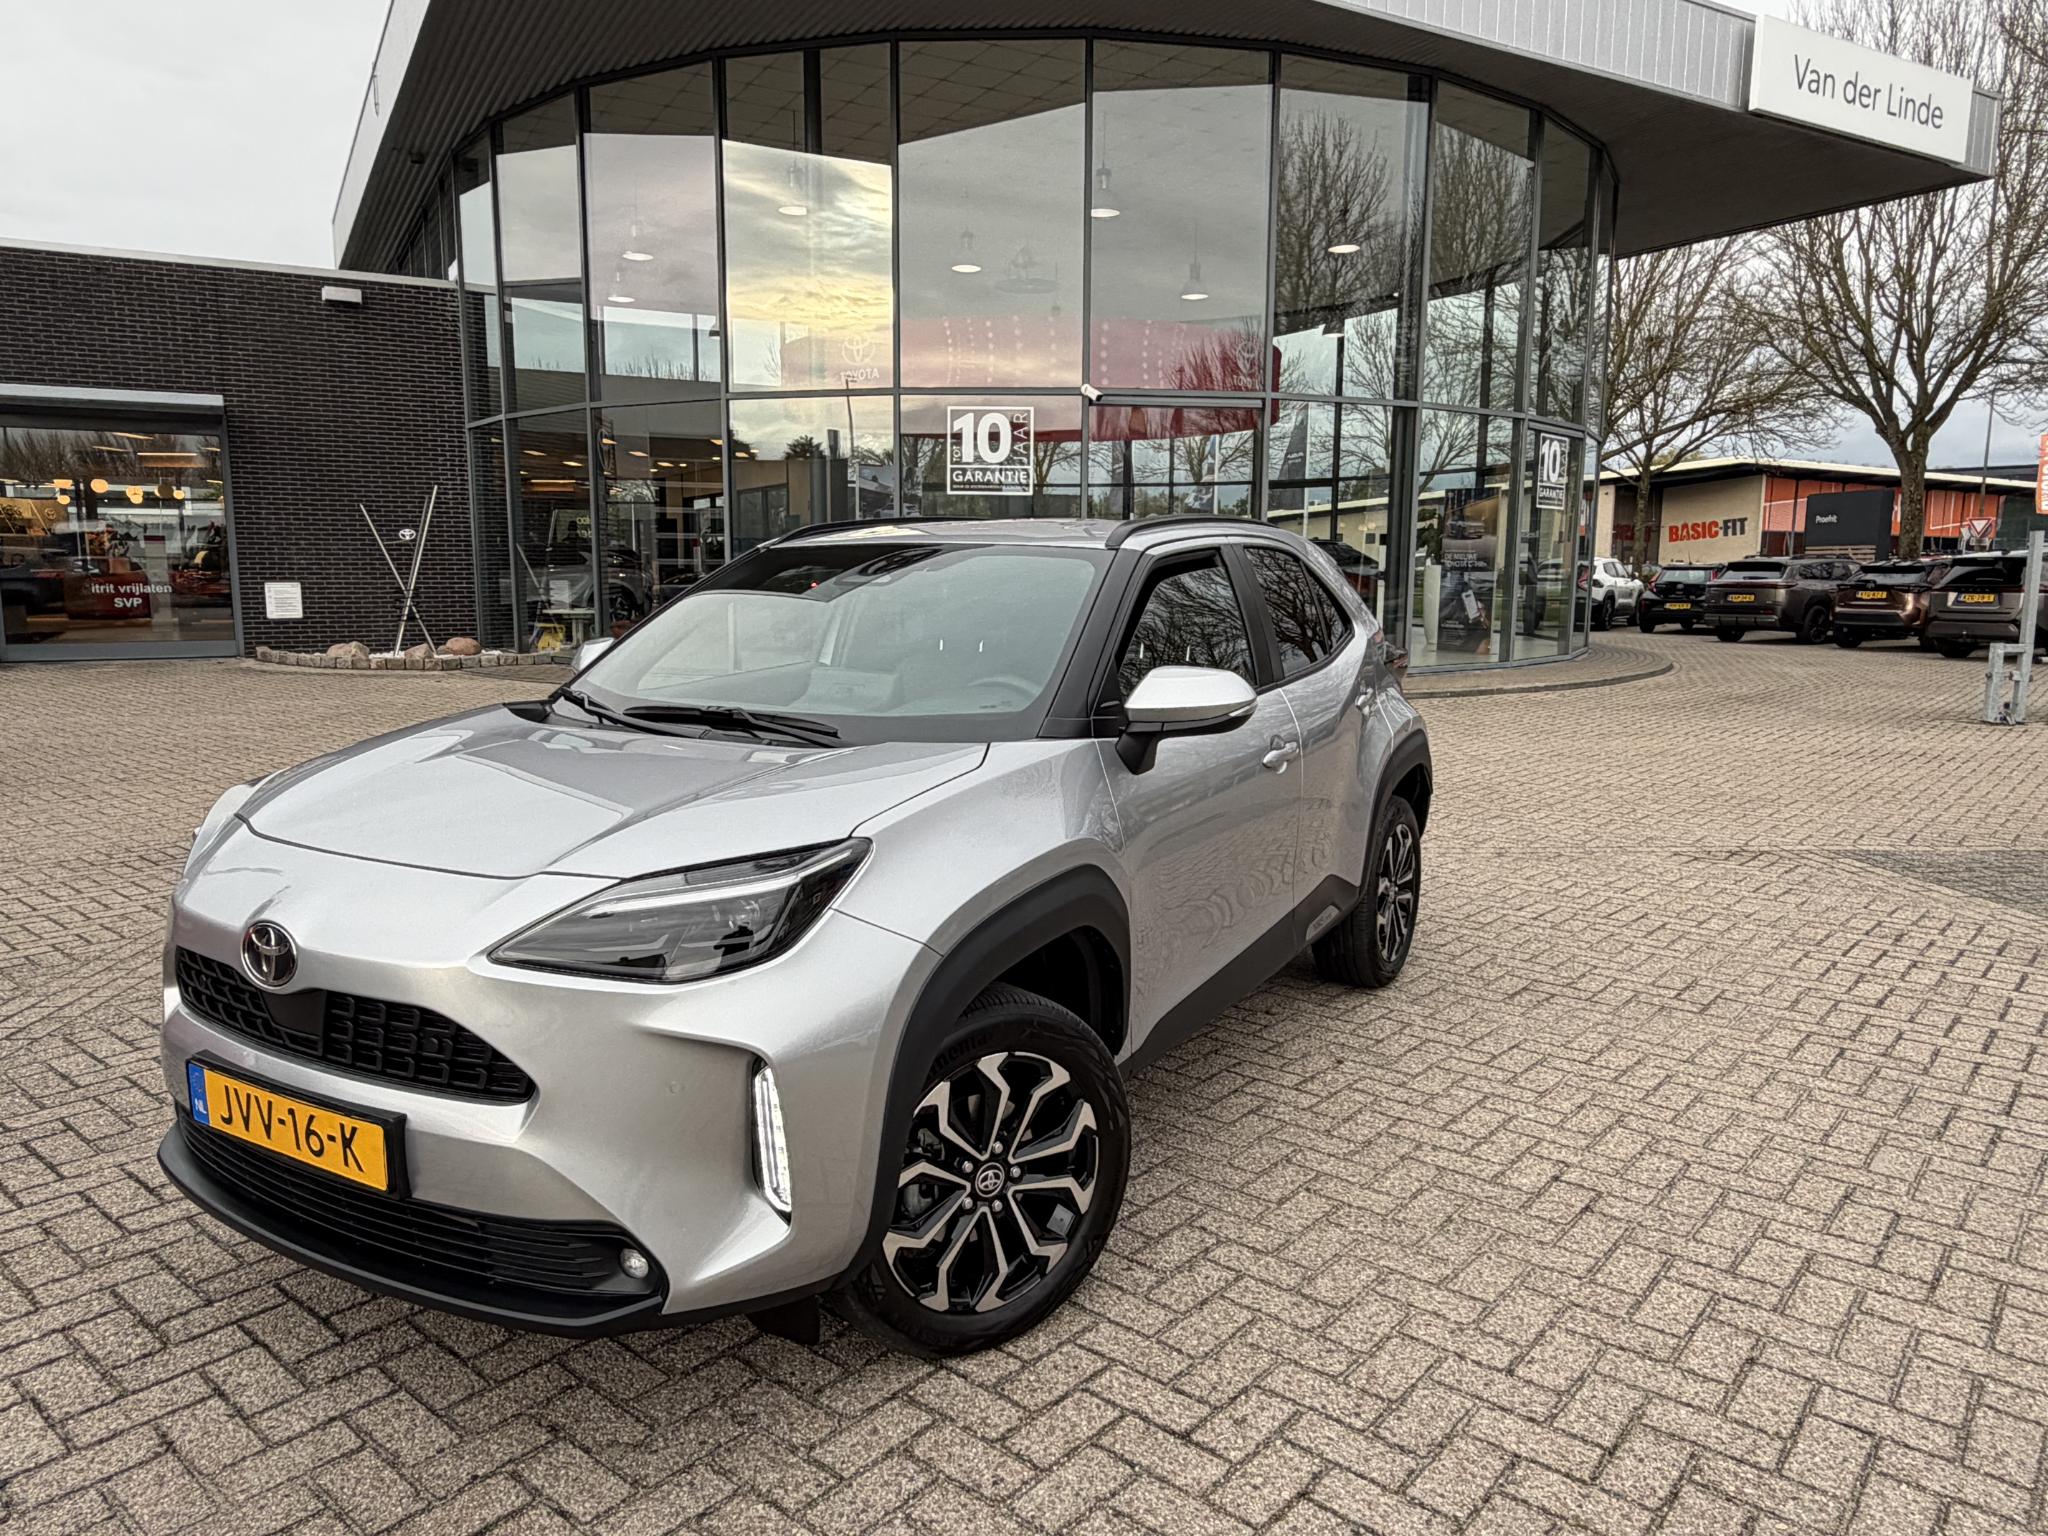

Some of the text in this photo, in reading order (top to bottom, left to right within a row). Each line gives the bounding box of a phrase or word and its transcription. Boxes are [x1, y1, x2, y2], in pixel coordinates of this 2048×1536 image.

[1794, 54, 1944, 129] Van der Linde
[952, 445, 961, 462] TOT
[953, 412, 1012, 463] 10
[1013, 413, 1028, 464] JAAR
[952, 470, 1028, 484] GARANTIE
[1541, 439, 1561, 483] 10
[1668, 517, 1748, 543] BASIC-FIT
[113, 597, 143, 608] SVP
[118, 583, 173, 595] vrijlaten
[220, 1084, 365, 1173] JVV-16-K
